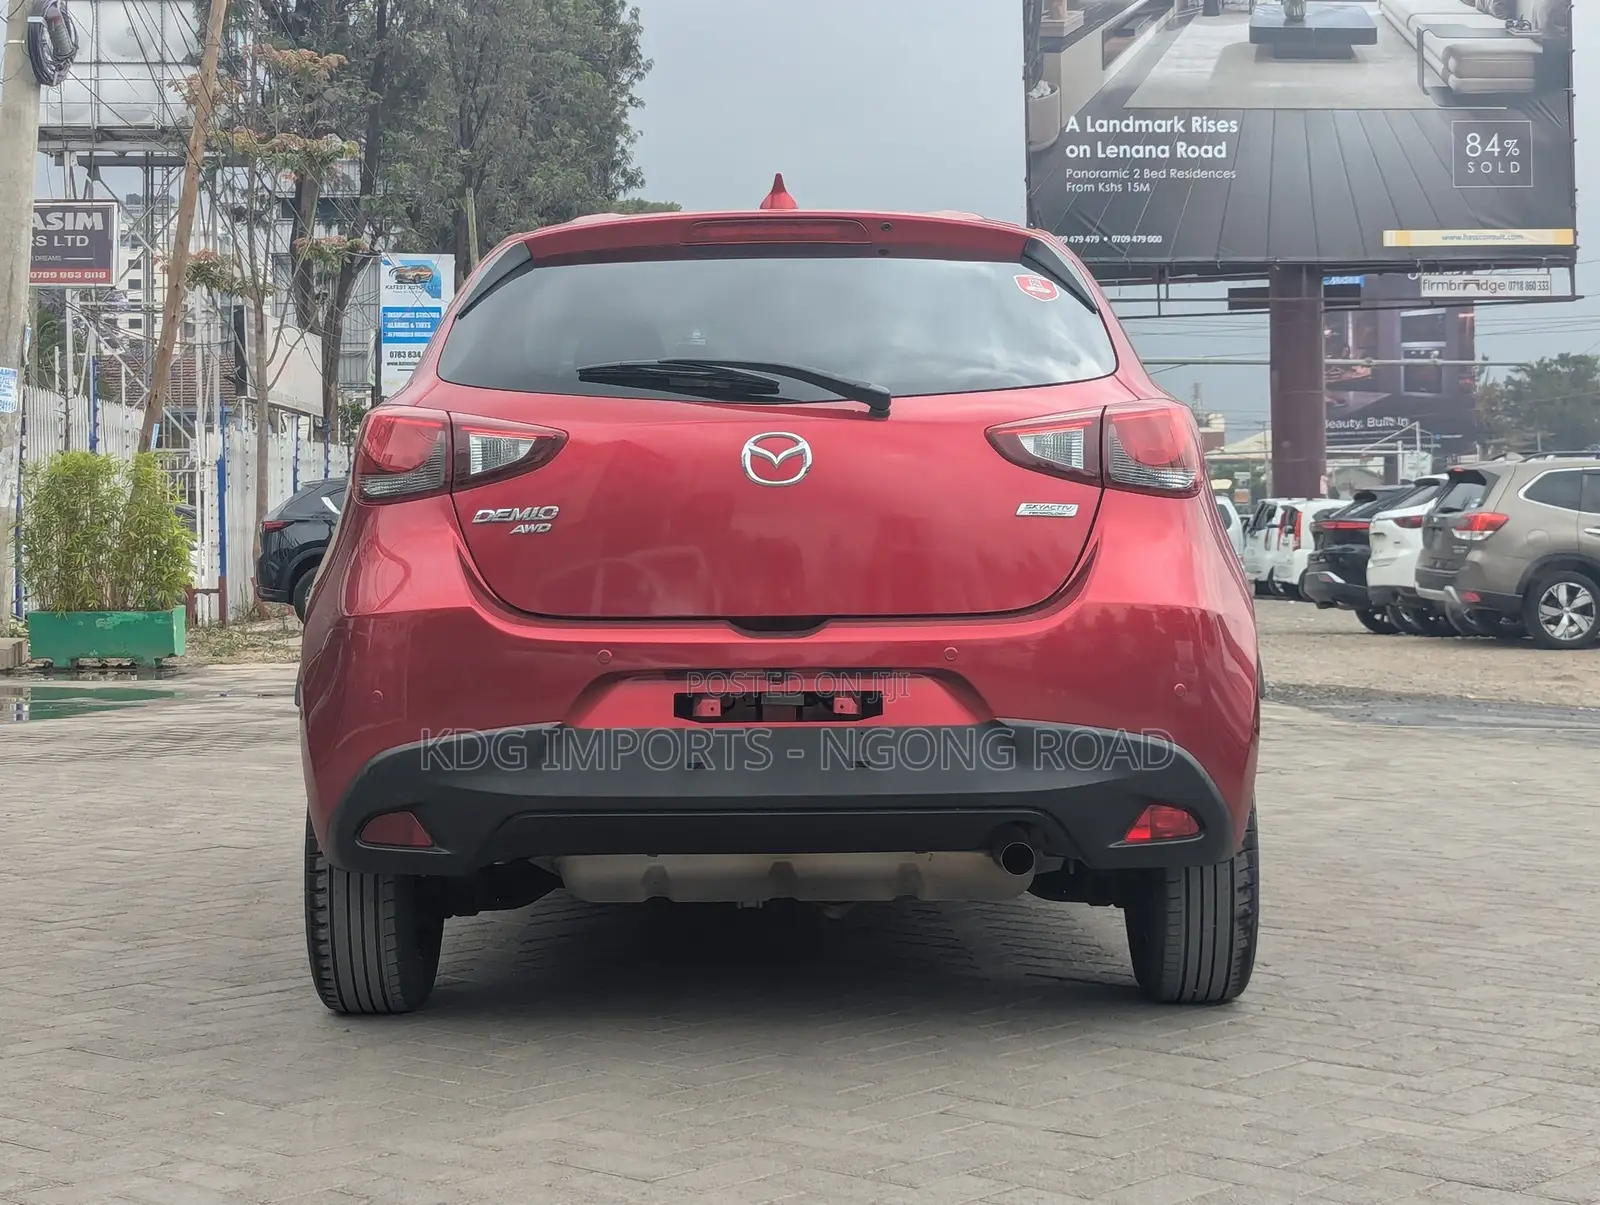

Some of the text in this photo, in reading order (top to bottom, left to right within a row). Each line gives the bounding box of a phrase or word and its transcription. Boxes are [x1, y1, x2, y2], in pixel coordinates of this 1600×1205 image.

[1065, 115, 1239, 133] A Landmark Rises
[1065, 141, 1227, 158] on Lenana Road
[1466, 132, 1520, 157] 84%
[1066, 168, 1237, 179] Panoramic 2 Bed Residences
[1467, 161, 1520, 174] SOLD
[1066, 182, 1151, 192] From Kshs 15M
[53, 235, 90, 247] LTD
[1069, 235, 1084, 243] 479
[1085, 235, 1100, 243] 479
[1111, 235, 1131, 243] 0709
[1132, 235, 1147, 243] 479
[1023, 503, 1073, 511] SKYACTIV
[471, 505, 559, 524] DEMIO
[508, 522, 552, 535] AWD
